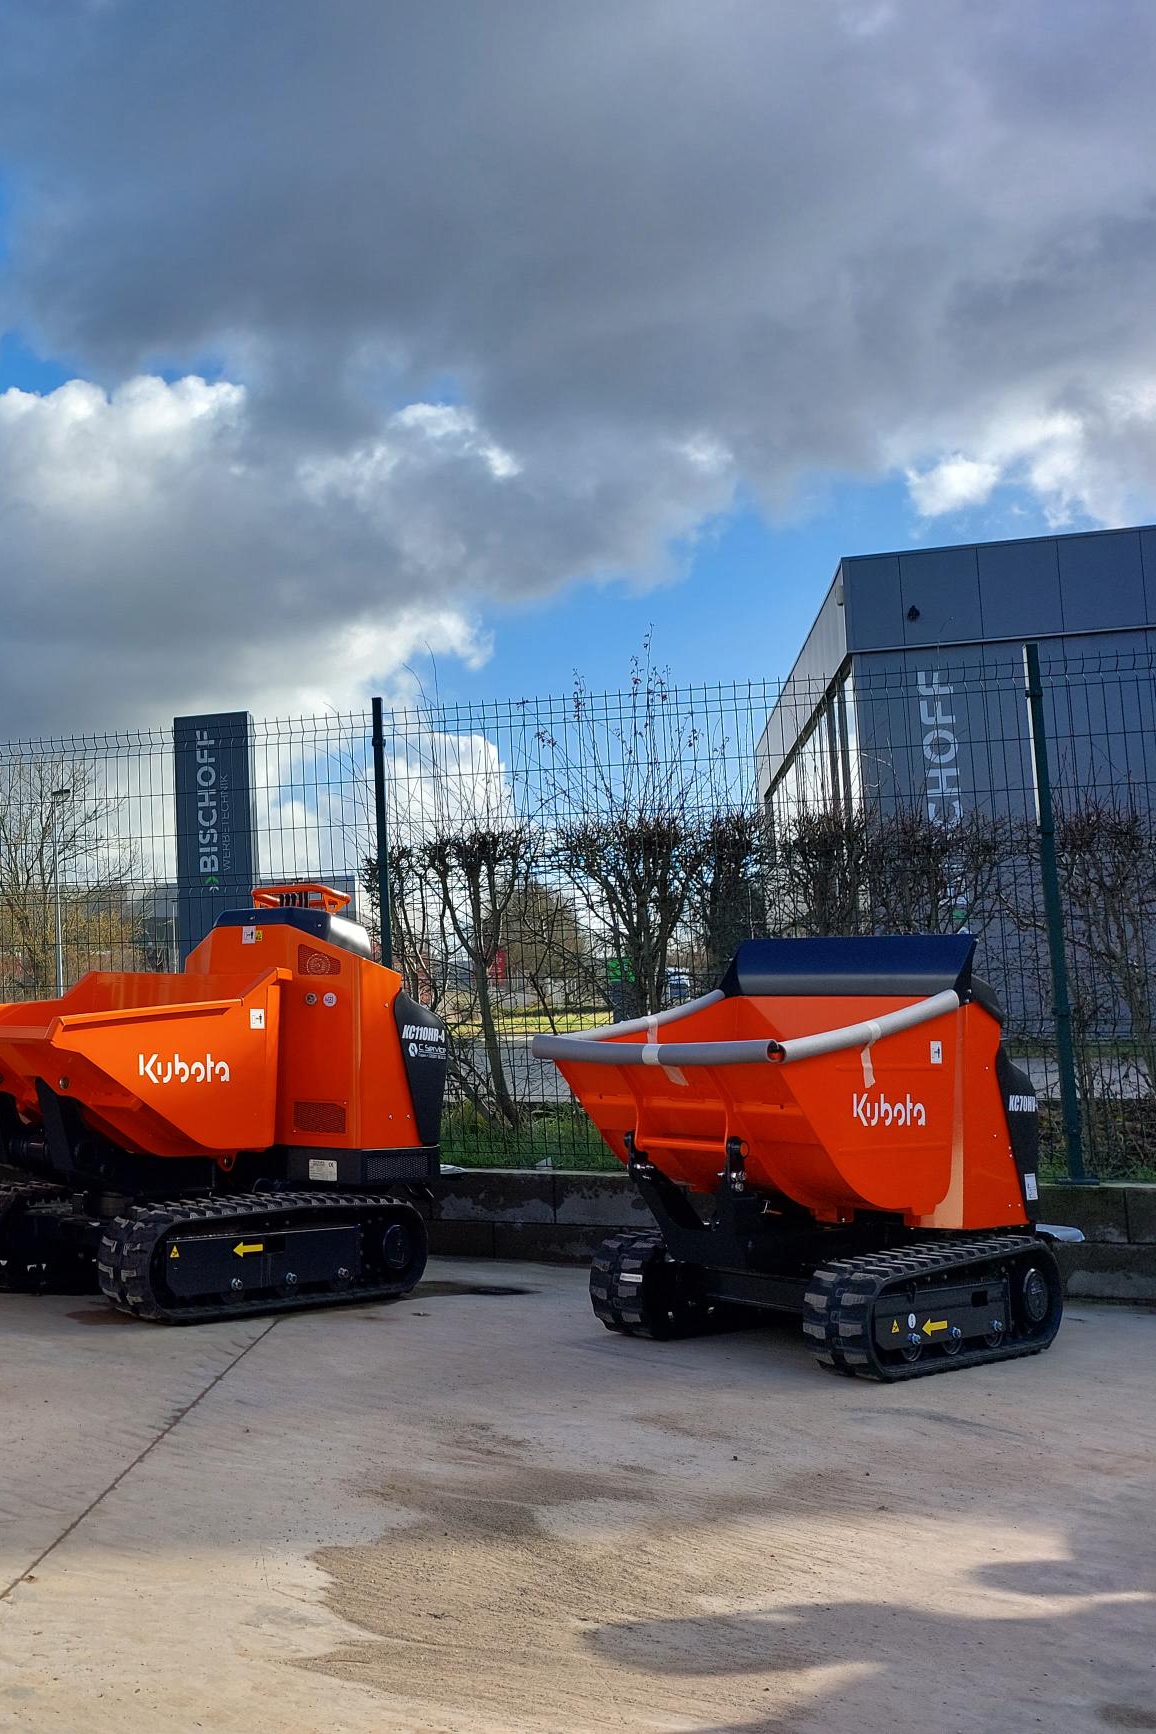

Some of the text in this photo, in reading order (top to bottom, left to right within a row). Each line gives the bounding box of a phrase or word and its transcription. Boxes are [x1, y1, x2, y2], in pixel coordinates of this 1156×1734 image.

[195, 730, 219, 873] BISCHOFF
[220, 774, 232, 871] WERBETECHNIK
[402, 1024, 445, 1043] KC110HR-4
[138, 1053, 230, 1084] Kubota
[852, 1093, 925, 1127] Kubota
